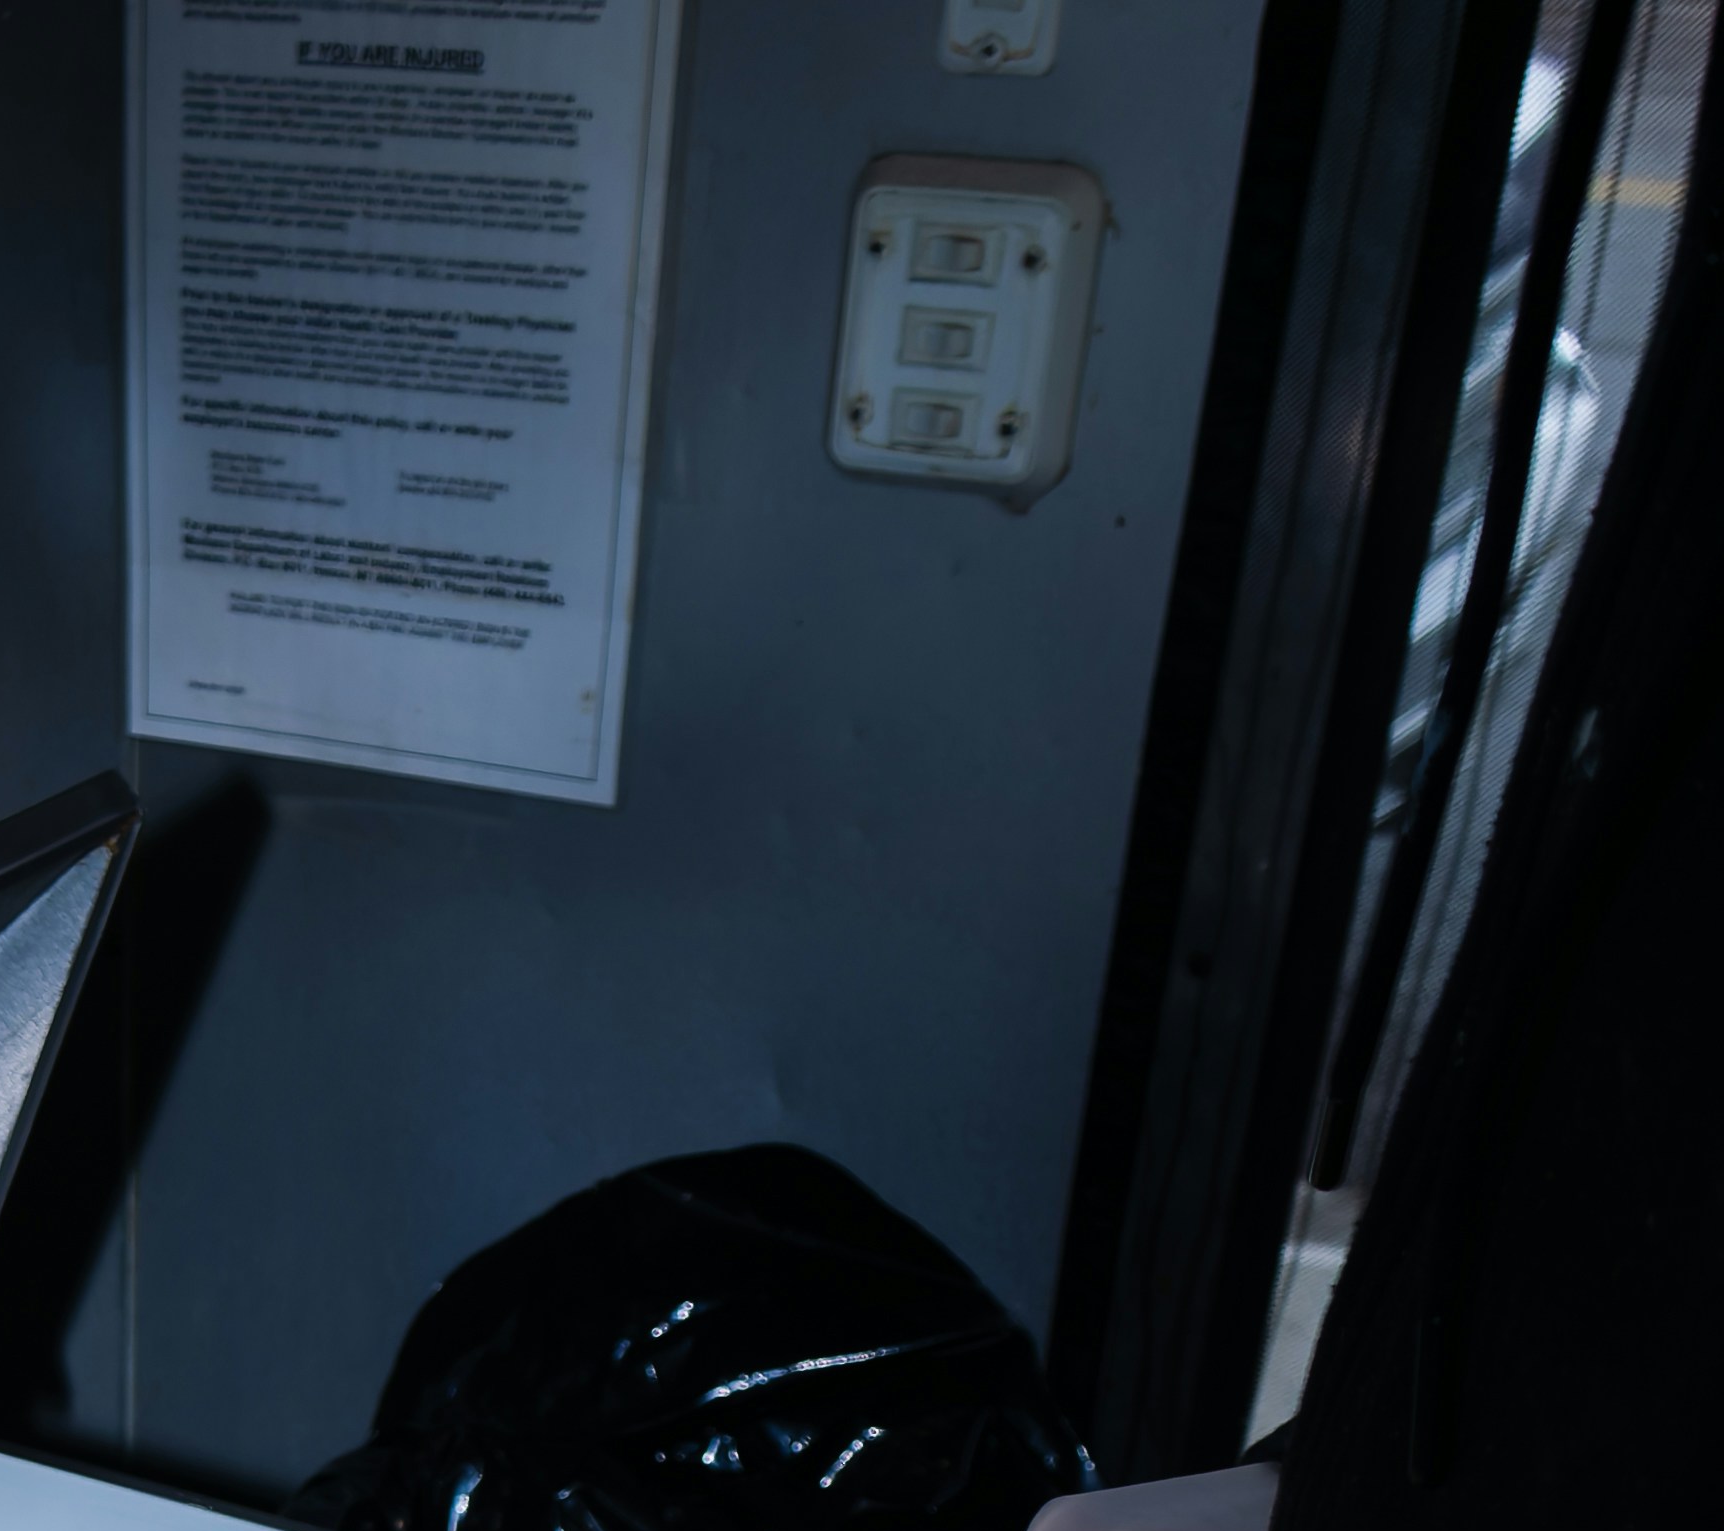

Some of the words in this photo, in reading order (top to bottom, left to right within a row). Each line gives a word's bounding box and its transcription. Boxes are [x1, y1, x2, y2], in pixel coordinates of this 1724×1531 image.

[297, 41, 313, 62] IF
[318, 42, 358, 63] YOU
[361, 45, 400, 66] ARE
[404, 47, 486, 71] INJURED
